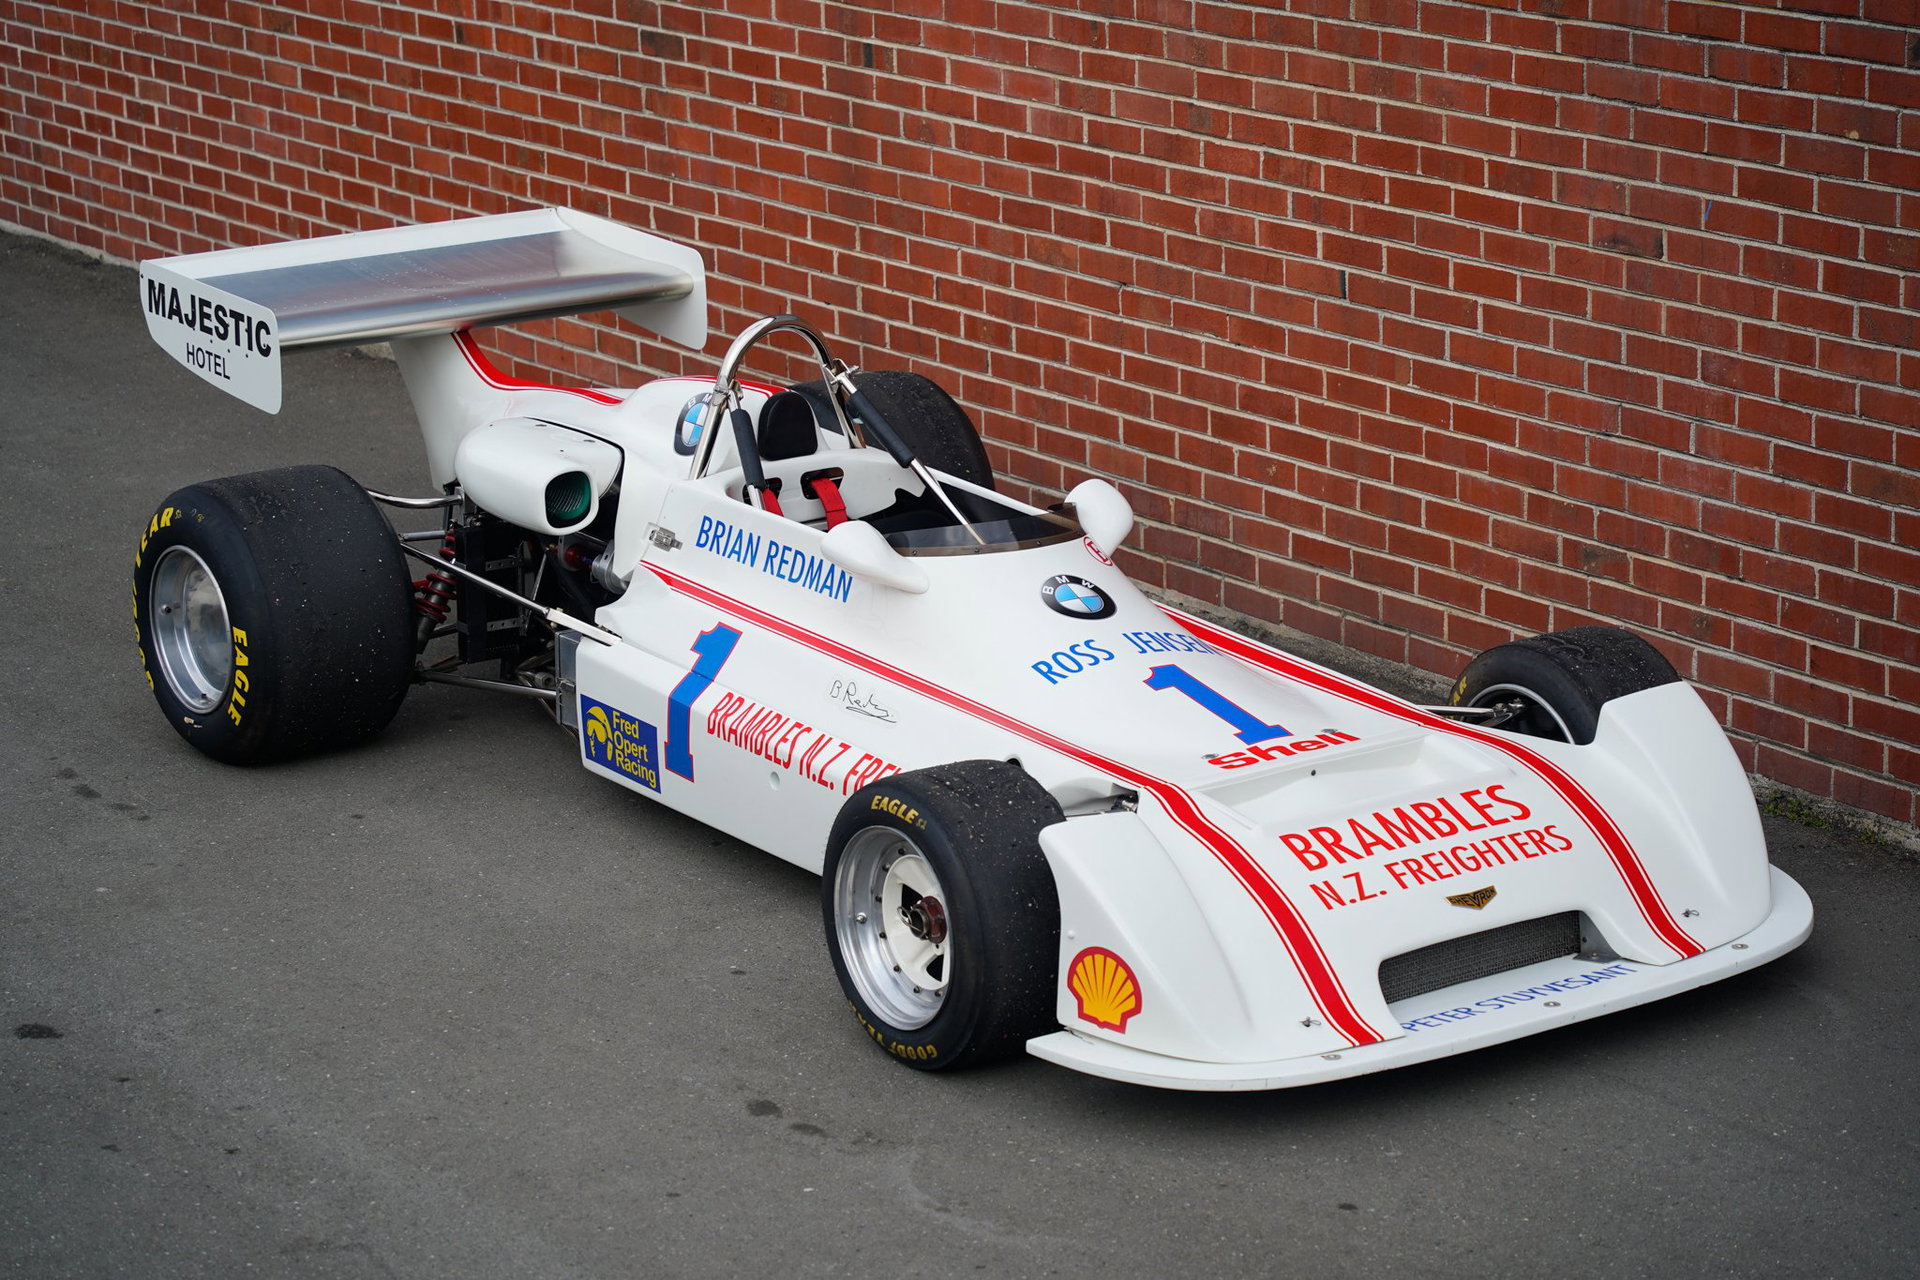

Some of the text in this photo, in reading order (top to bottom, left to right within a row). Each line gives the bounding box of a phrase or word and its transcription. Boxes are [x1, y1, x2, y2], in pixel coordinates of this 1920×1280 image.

[148, 278, 272, 358] MAJESTIC
[186, 342, 231, 380] HOTEL
[695, 515, 853, 603] BRIAN REDMAN
[1042, 575, 1095, 595] BMW
[228, 626, 250, 727] EAGLE
[1031, 639, 1115, 685] ROSS
[612, 711, 640, 739] Fred
[664, 621, 743, 783] 1
[1142, 664, 1294, 745] 1
[614, 733, 649, 762] Opert
[615, 751, 657, 788] Racing
[707, 691, 813, 770] BRAMBLES
[799, 733, 851, 790] N.Z.
[1208, 731, 1361, 769] Shell
[871, 795, 919, 824] EAGLE
[1279, 784, 1531, 872] BRAMBLES
[1309, 825, 1573, 911] N.Z. FREIGHTERS
[1400, 964, 1638, 1032] PETER STUYVESANT
